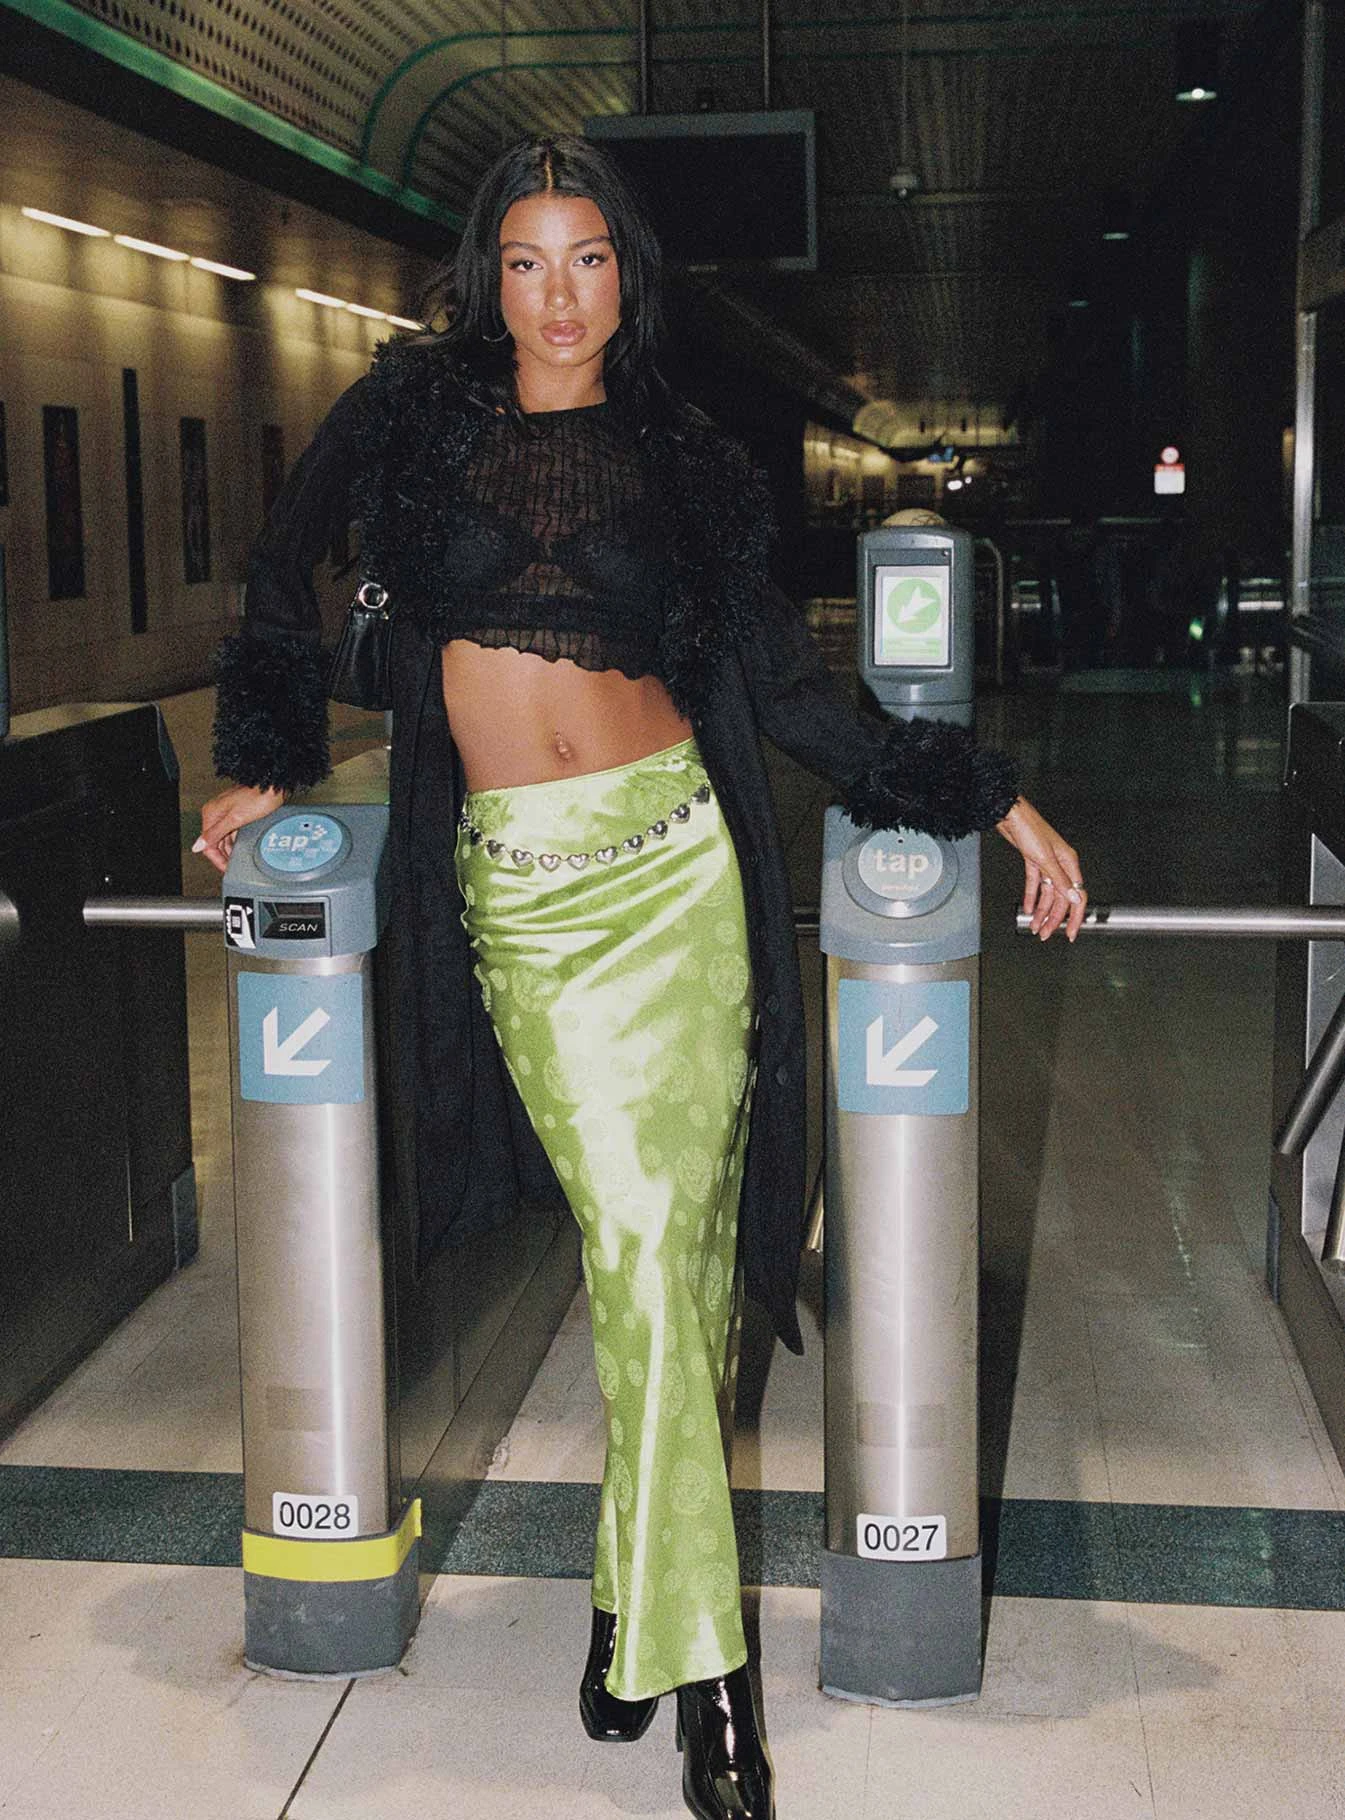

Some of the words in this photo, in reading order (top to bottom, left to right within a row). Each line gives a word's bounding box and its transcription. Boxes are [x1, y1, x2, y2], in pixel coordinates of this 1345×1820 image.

[267, 832, 309, 852] tap
[874, 848, 929, 880] tap
[279, 923, 318, 932] SCAN
[280, 1501, 351, 1530] 0028
[864, 1523, 939, 1552] 0027
